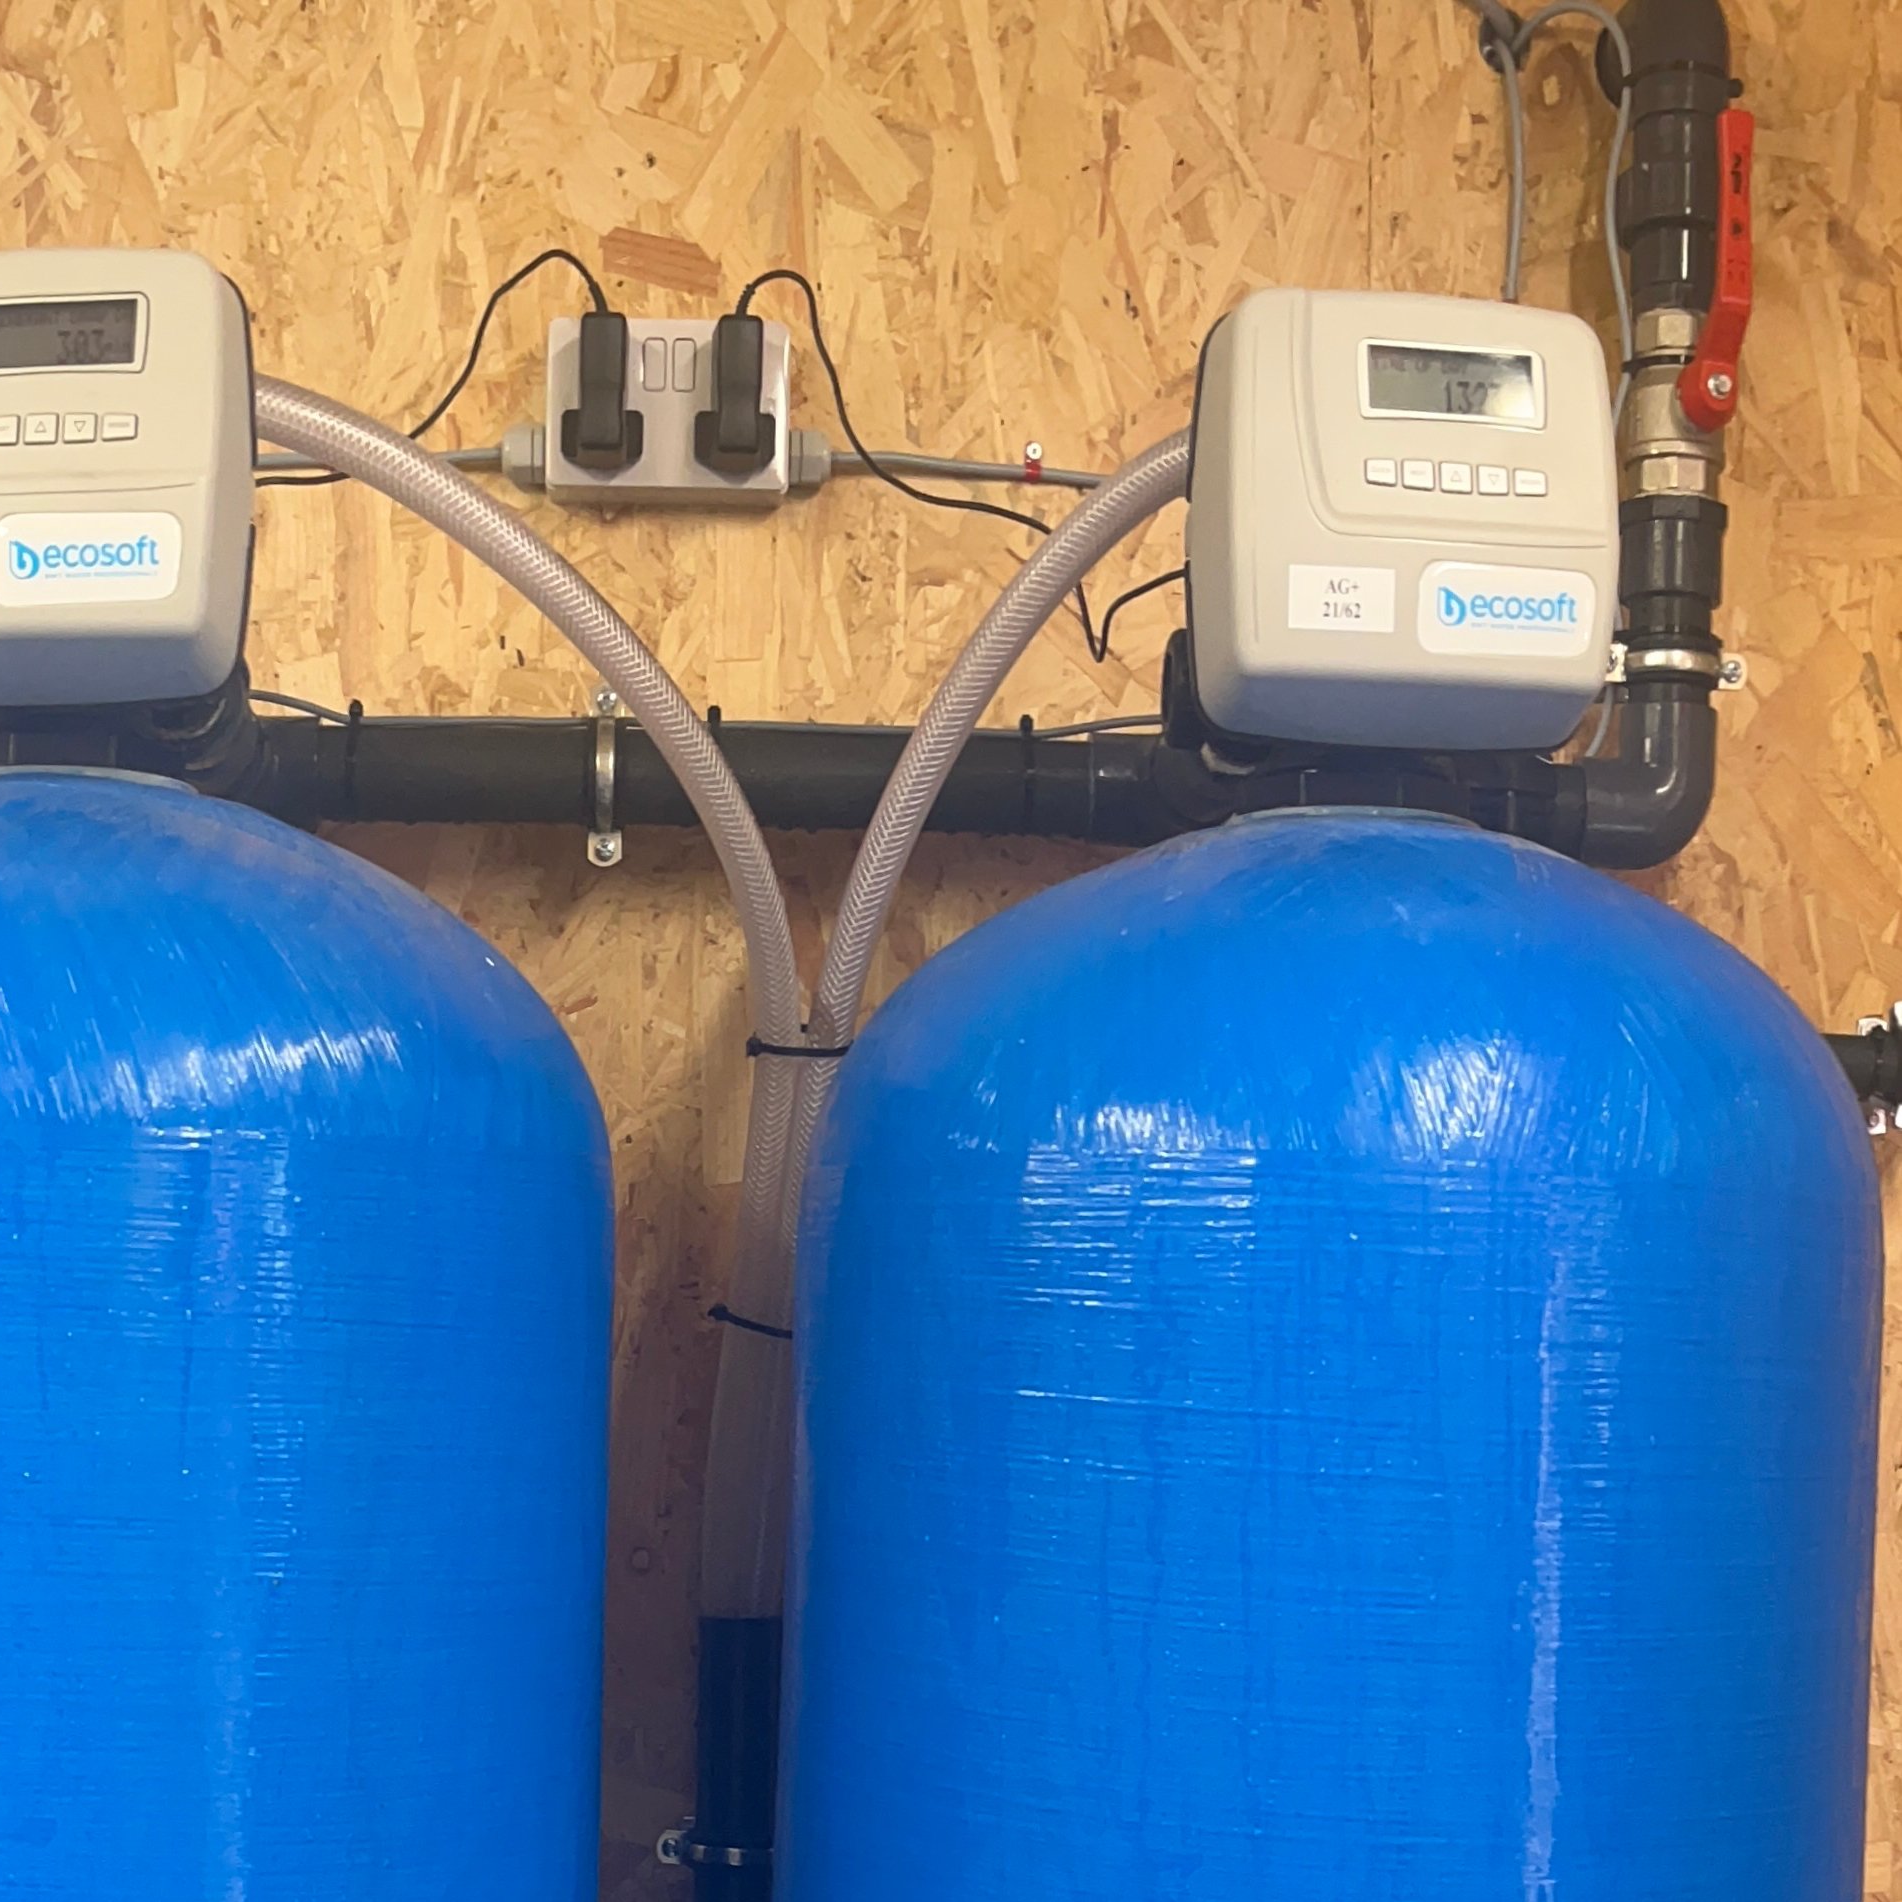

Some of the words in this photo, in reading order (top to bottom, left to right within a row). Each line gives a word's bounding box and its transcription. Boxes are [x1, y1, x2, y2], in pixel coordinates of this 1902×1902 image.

[42, 534, 159, 569] ecosoft
[1324, 577, 1360, 595] AG+
[1322, 600, 1361, 619] 21/62
[1469, 591, 1577, 623] ecosoft
